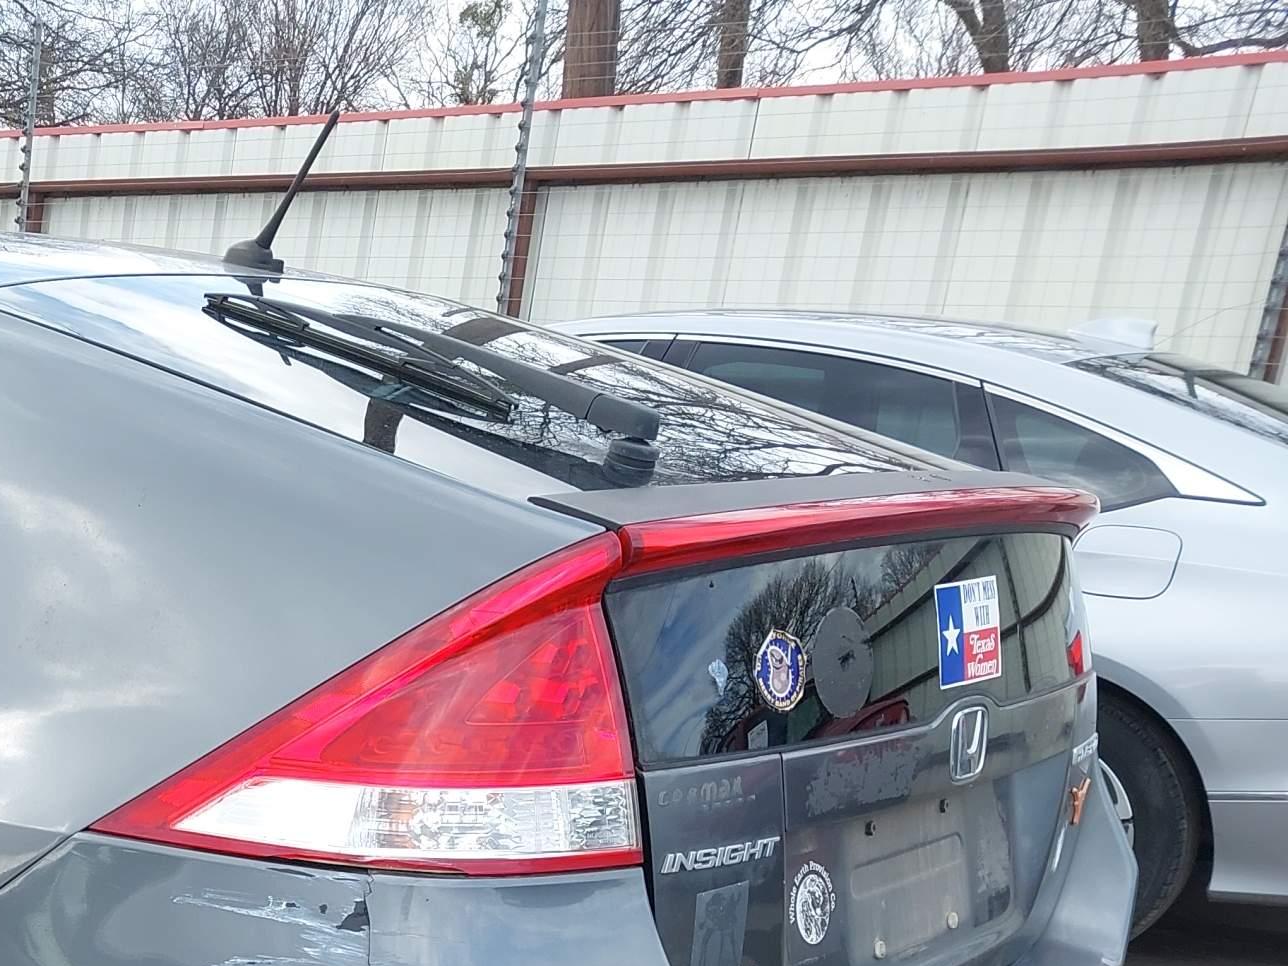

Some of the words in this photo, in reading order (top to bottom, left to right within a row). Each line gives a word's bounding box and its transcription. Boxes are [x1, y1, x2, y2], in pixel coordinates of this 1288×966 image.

[962, 581, 981, 604] DON'T
[982, 579, 996, 601] MESS
[974, 605, 990, 627] WITH
[969, 633, 996, 655] Texas
[967, 654, 998, 679] Women
[660, 836, 781, 874] INSIGHT
[788, 885, 798, 925] Whole
[794, 863, 810, 887] Earth
[809, 860, 833, 893] Provision
